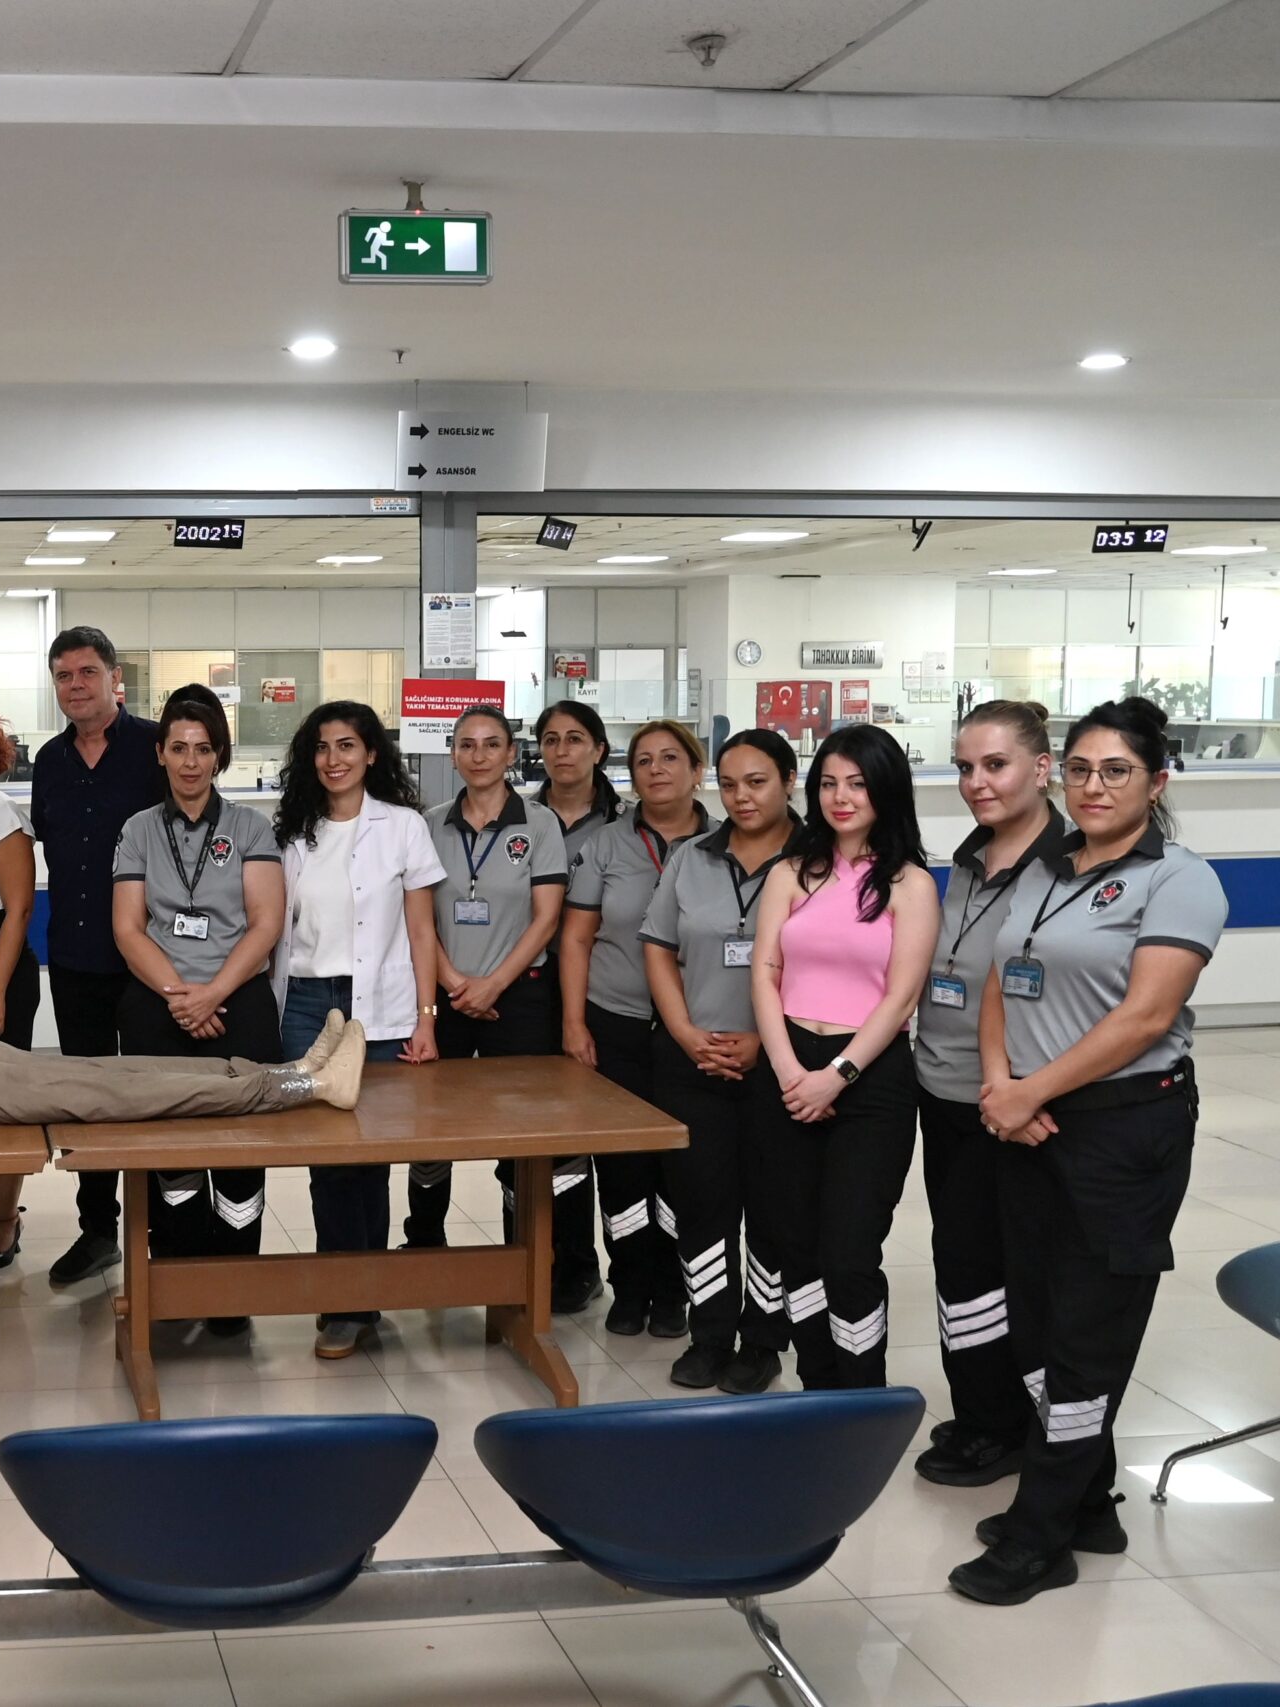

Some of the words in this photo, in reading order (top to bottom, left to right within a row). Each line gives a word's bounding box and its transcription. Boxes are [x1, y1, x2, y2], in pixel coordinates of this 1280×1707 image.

[437, 425, 480, 437] ENGELSİZ
[481, 427, 495, 437] WC
[435, 465, 477, 476] ASANSÖR
[176, 526, 221, 541] 2002
[222, 524, 243, 539] 15
[1095, 529, 1135, 547] 035
[1144, 528, 1166, 543] 12
[812, 649, 850, 664] TAHAKKUK
[851, 646, 876, 664] BİRİMİ
[404, 695, 444, 703] SAĞLIĞIMIZI
[427, 703, 462, 711] TEMASTAN
